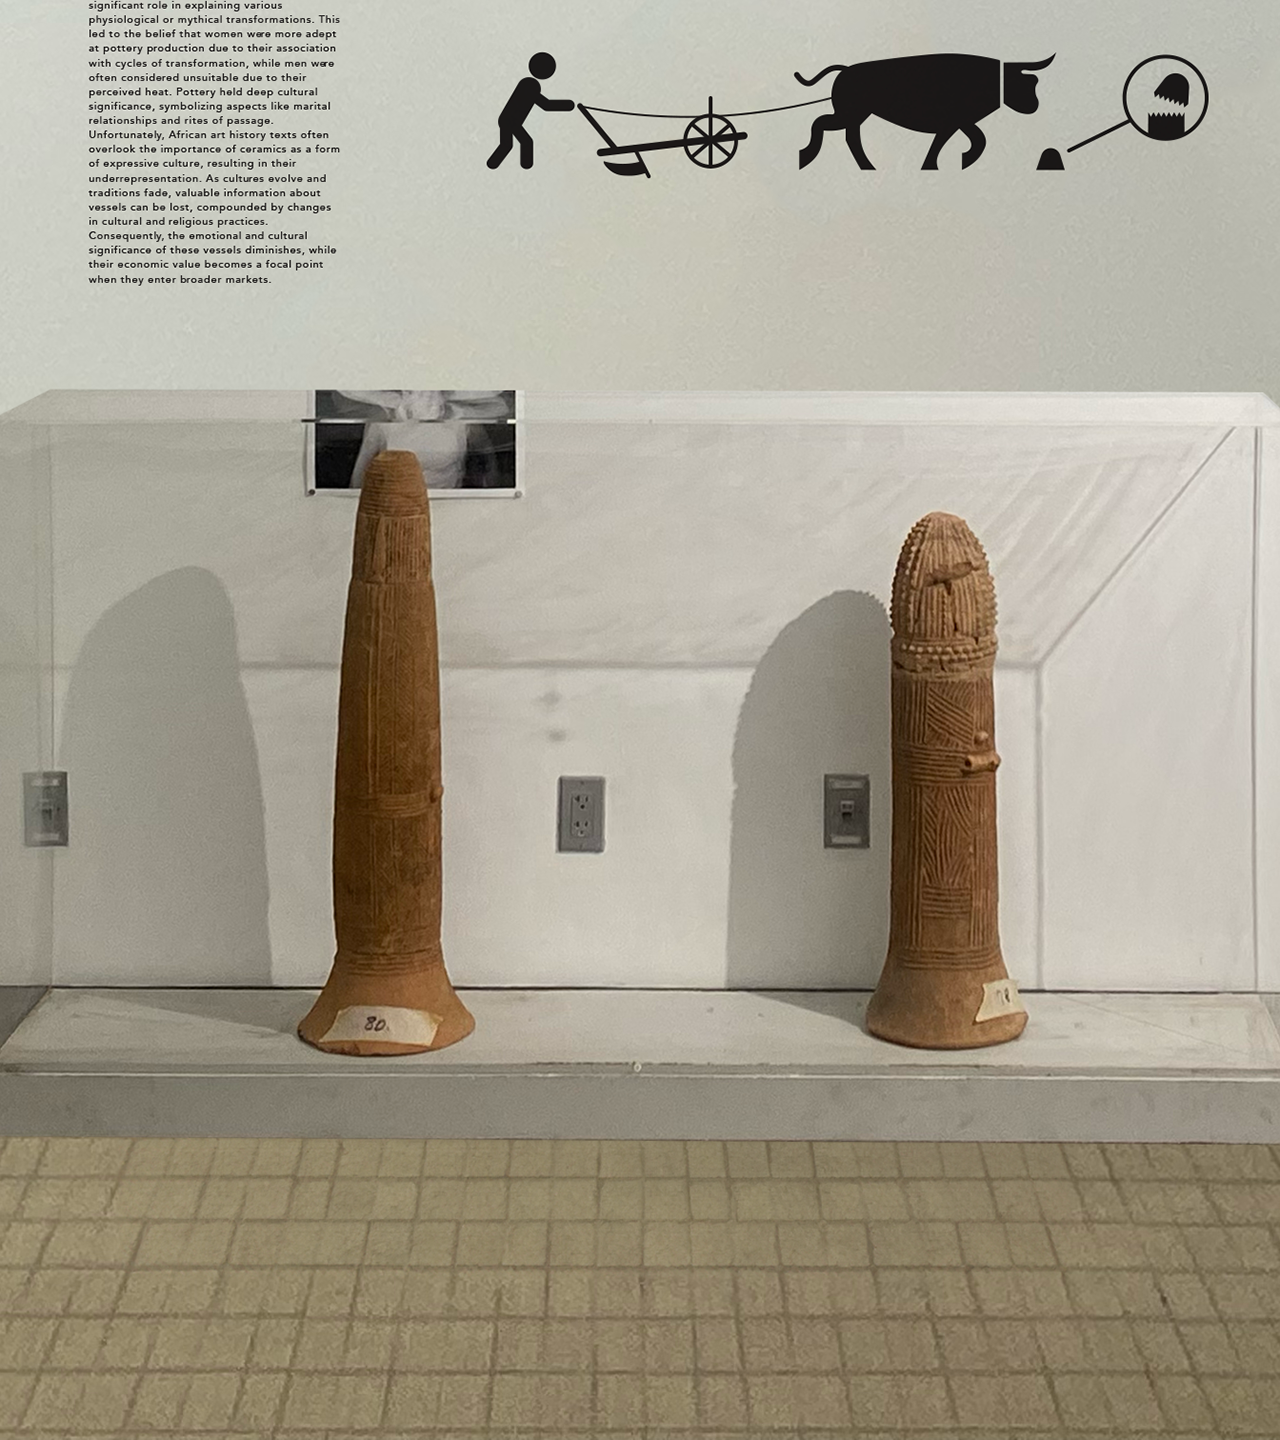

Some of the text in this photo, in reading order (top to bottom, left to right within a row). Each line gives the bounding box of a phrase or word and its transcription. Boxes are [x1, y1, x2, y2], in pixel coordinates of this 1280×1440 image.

[88, 43, 337, 56] at pottery production due to their association
[88, 187, 321, 199] traditions fade, valuable information about
[88, 274, 272, 287] when they enter broader markets.
